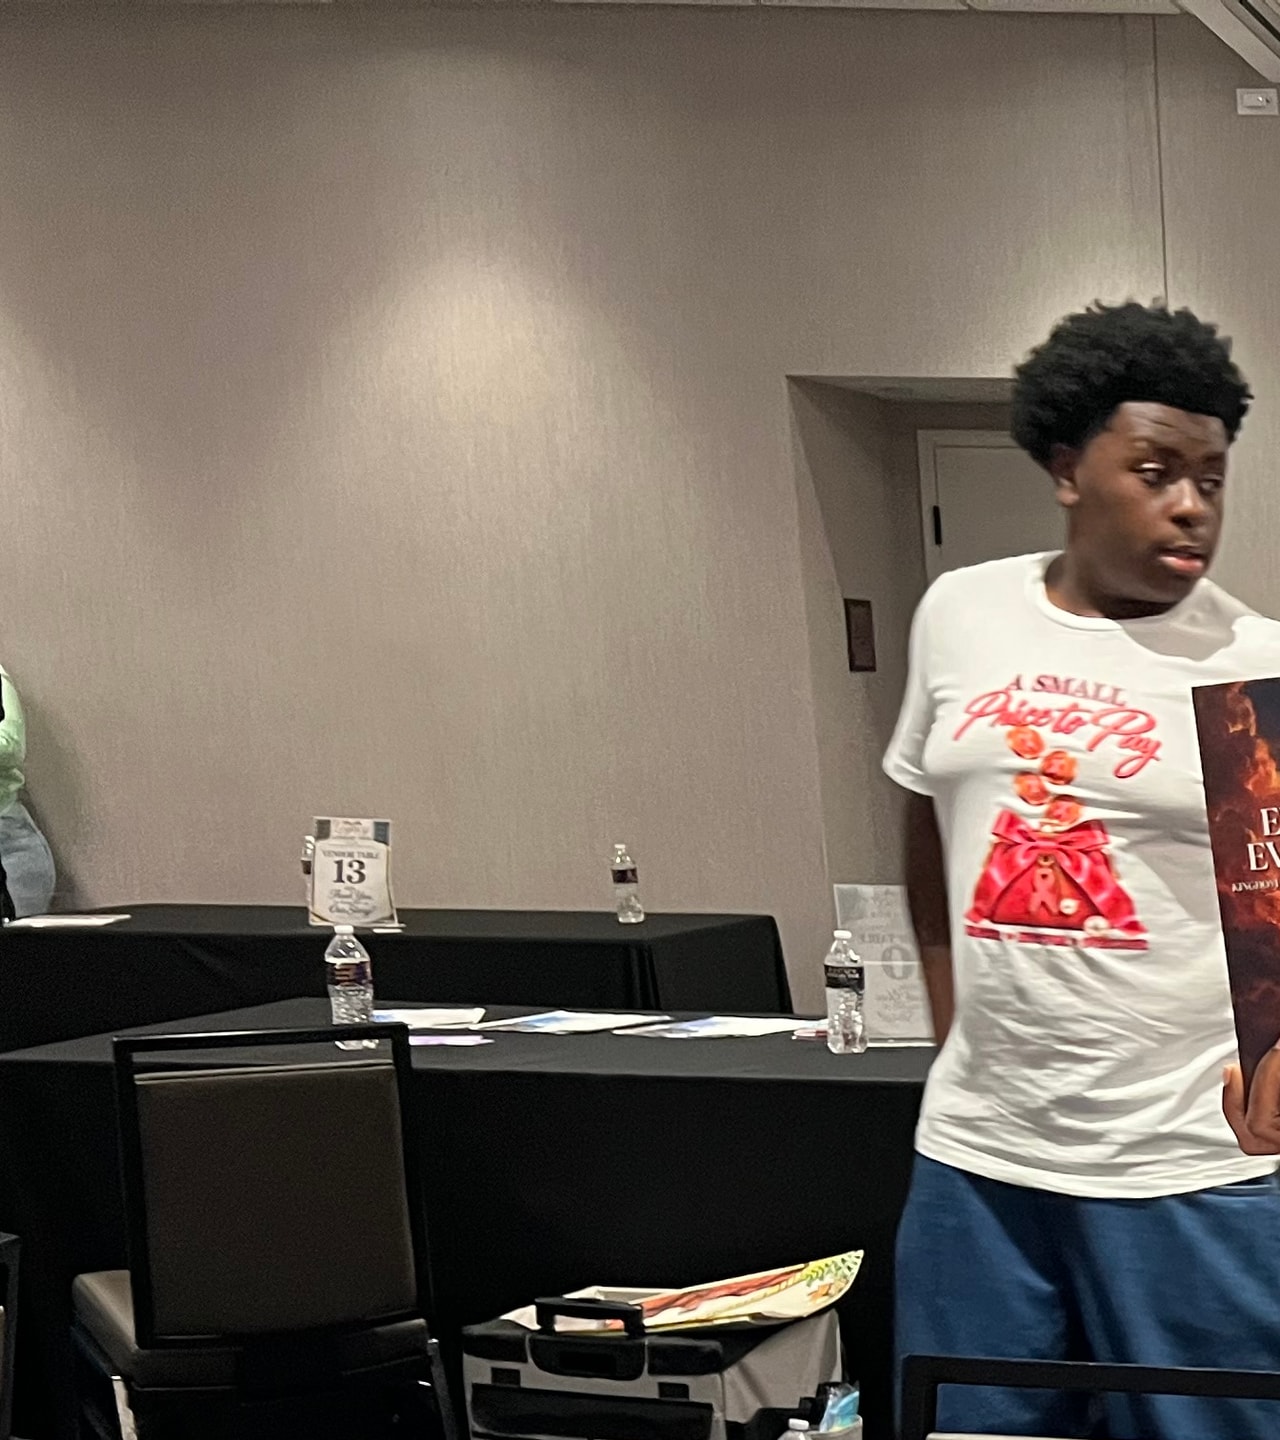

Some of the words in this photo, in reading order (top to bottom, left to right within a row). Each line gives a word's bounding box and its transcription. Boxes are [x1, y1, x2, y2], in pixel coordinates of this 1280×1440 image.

[1008, 674, 1024, 691] A
[1032, 674, 1128, 707] SMALL
[1087, 707, 1161, 778] Pay
[333, 859, 366, 884] 13
